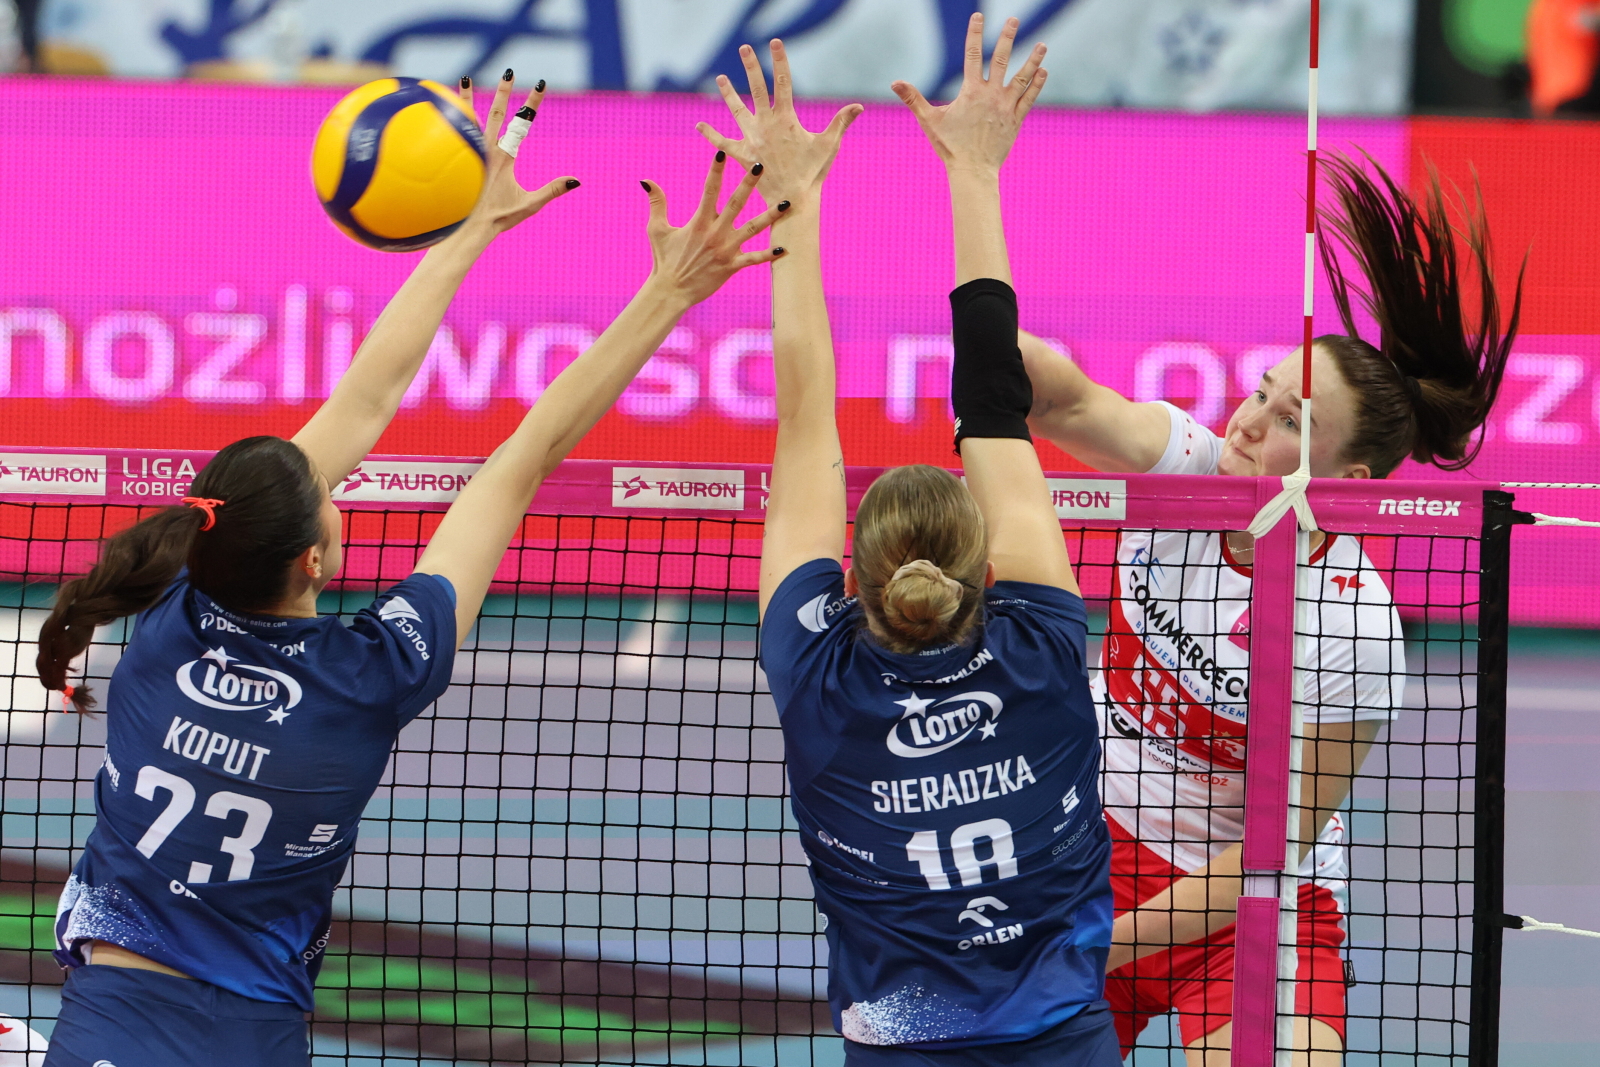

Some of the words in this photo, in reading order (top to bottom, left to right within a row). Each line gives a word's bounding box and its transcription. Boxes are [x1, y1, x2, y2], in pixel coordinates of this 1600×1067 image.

[17, 466, 98, 483] TAURON
[122, 457, 197, 480] LIGA
[376, 472, 473, 492] TAURON
[656, 481, 737, 499] TAURON
[1052, 490, 1110, 508] RON
[1378, 496, 1461, 517] netex
[824, 596, 859, 617] LICE
[395, 617, 430, 661] POLICE
[202, 664, 278, 702] LOTTO
[1183, 674, 1200, 696] DLA
[909, 702, 981, 746] LOTTO
[163, 715, 271, 781] KOPUT
[871, 755, 1037, 813] SIERADZKA
[134, 765, 273, 883] 23
[906, 818, 1018, 890] 18
[957, 922, 1025, 951] ORLEN
